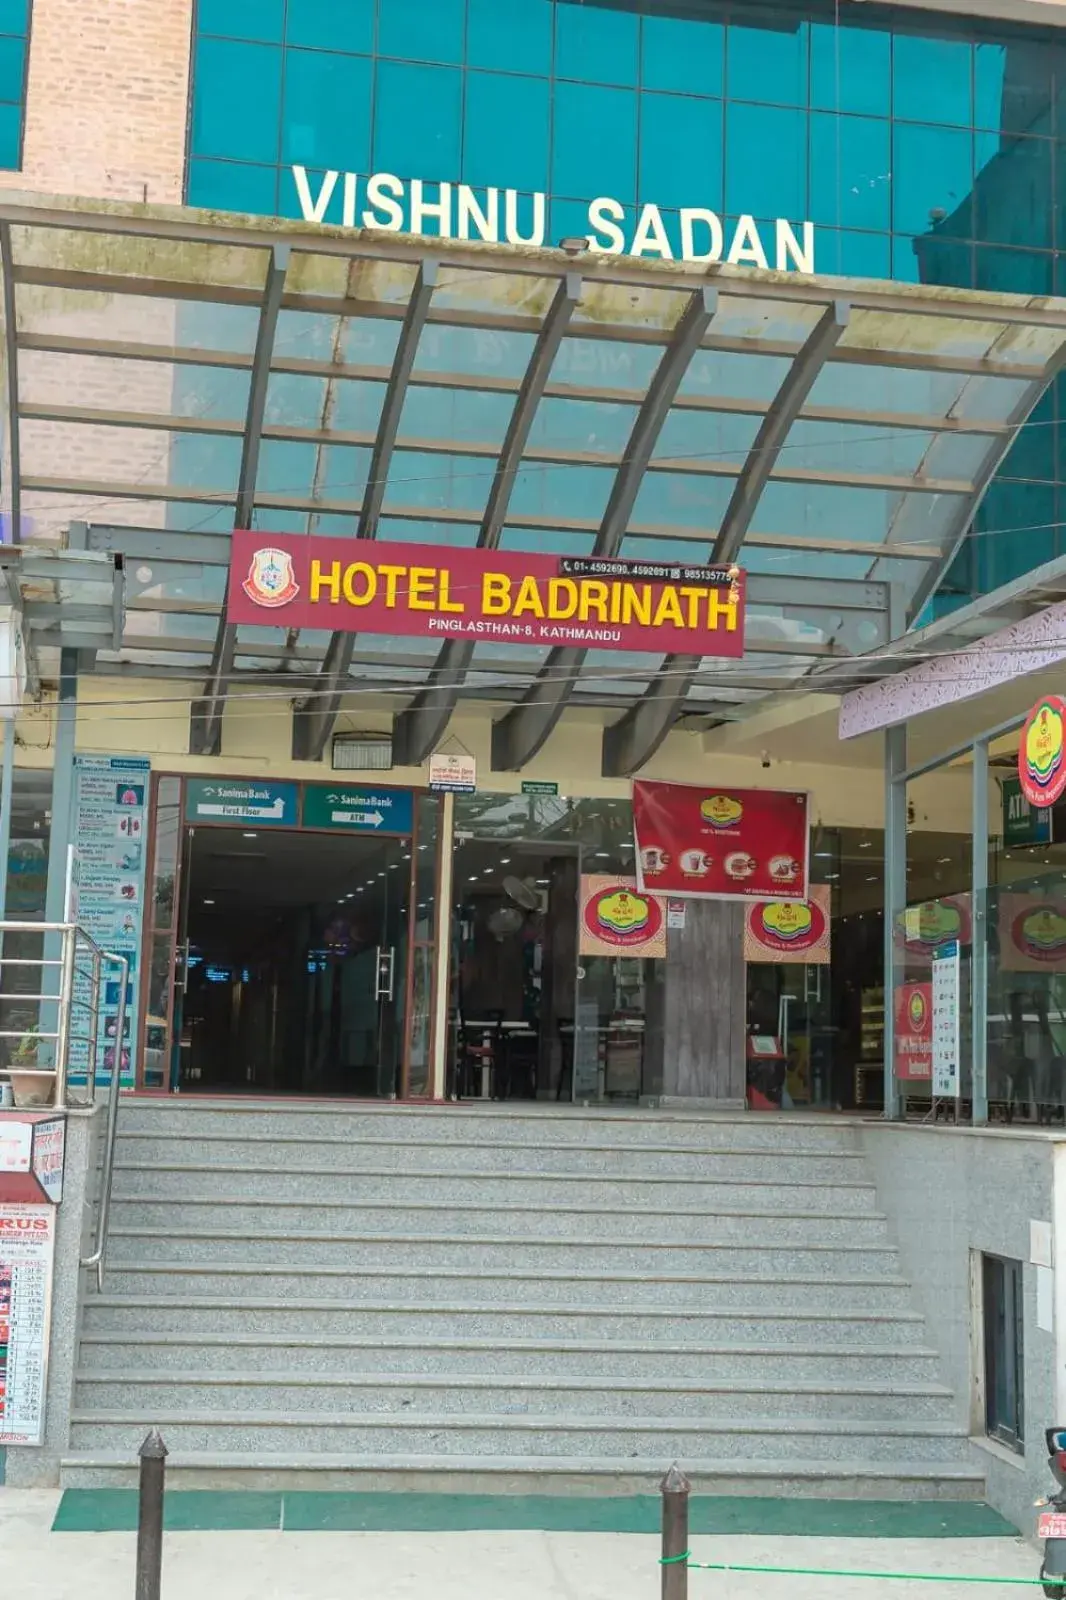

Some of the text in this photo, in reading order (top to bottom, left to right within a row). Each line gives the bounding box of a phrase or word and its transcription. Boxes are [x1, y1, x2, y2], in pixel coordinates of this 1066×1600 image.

[292, 165, 814, 274] VISHNU SADAN
[310, 559, 465, 614] HOTEL
[481, 572, 738, 631] BADRINATH
[540, 627, 621, 641] KATHMANDU
[222, 807, 261, 817] First Floor
[350, 814, 365, 822] ATM
